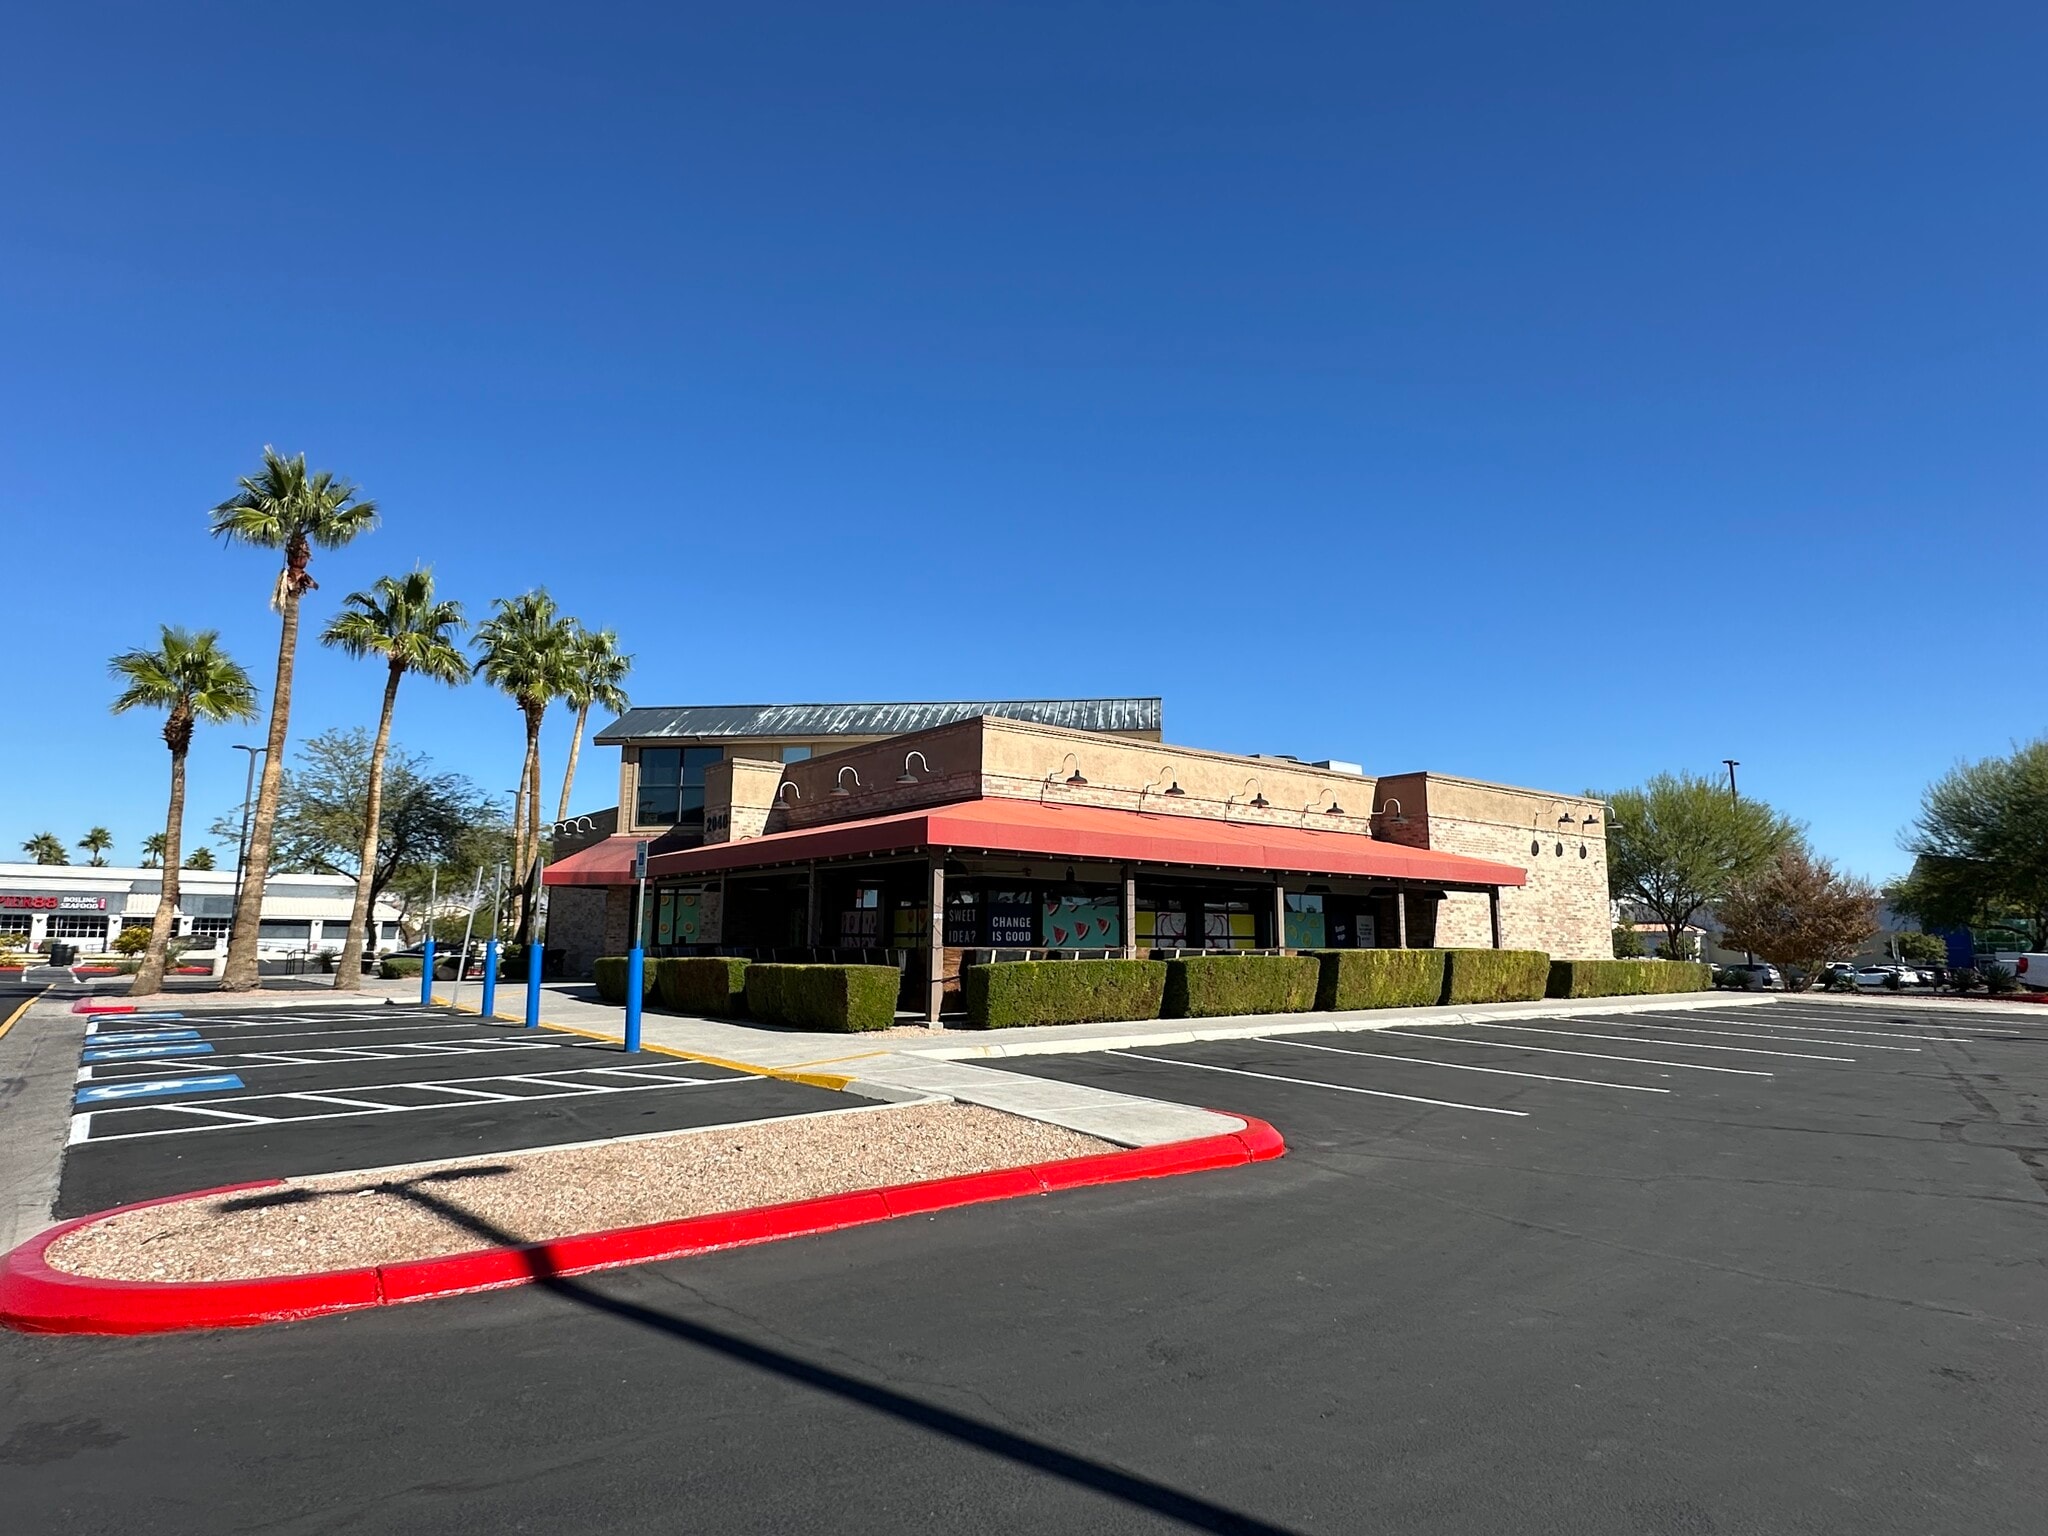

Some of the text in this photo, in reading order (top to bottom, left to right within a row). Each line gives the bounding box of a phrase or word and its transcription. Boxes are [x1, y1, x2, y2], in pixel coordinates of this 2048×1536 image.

[948, 909, 977, 922] SWEET
[992, 916, 1031, 928] CHANGE
[948, 930, 977, 943] IDEA?
[992, 931, 1031, 942] IS GOOD
